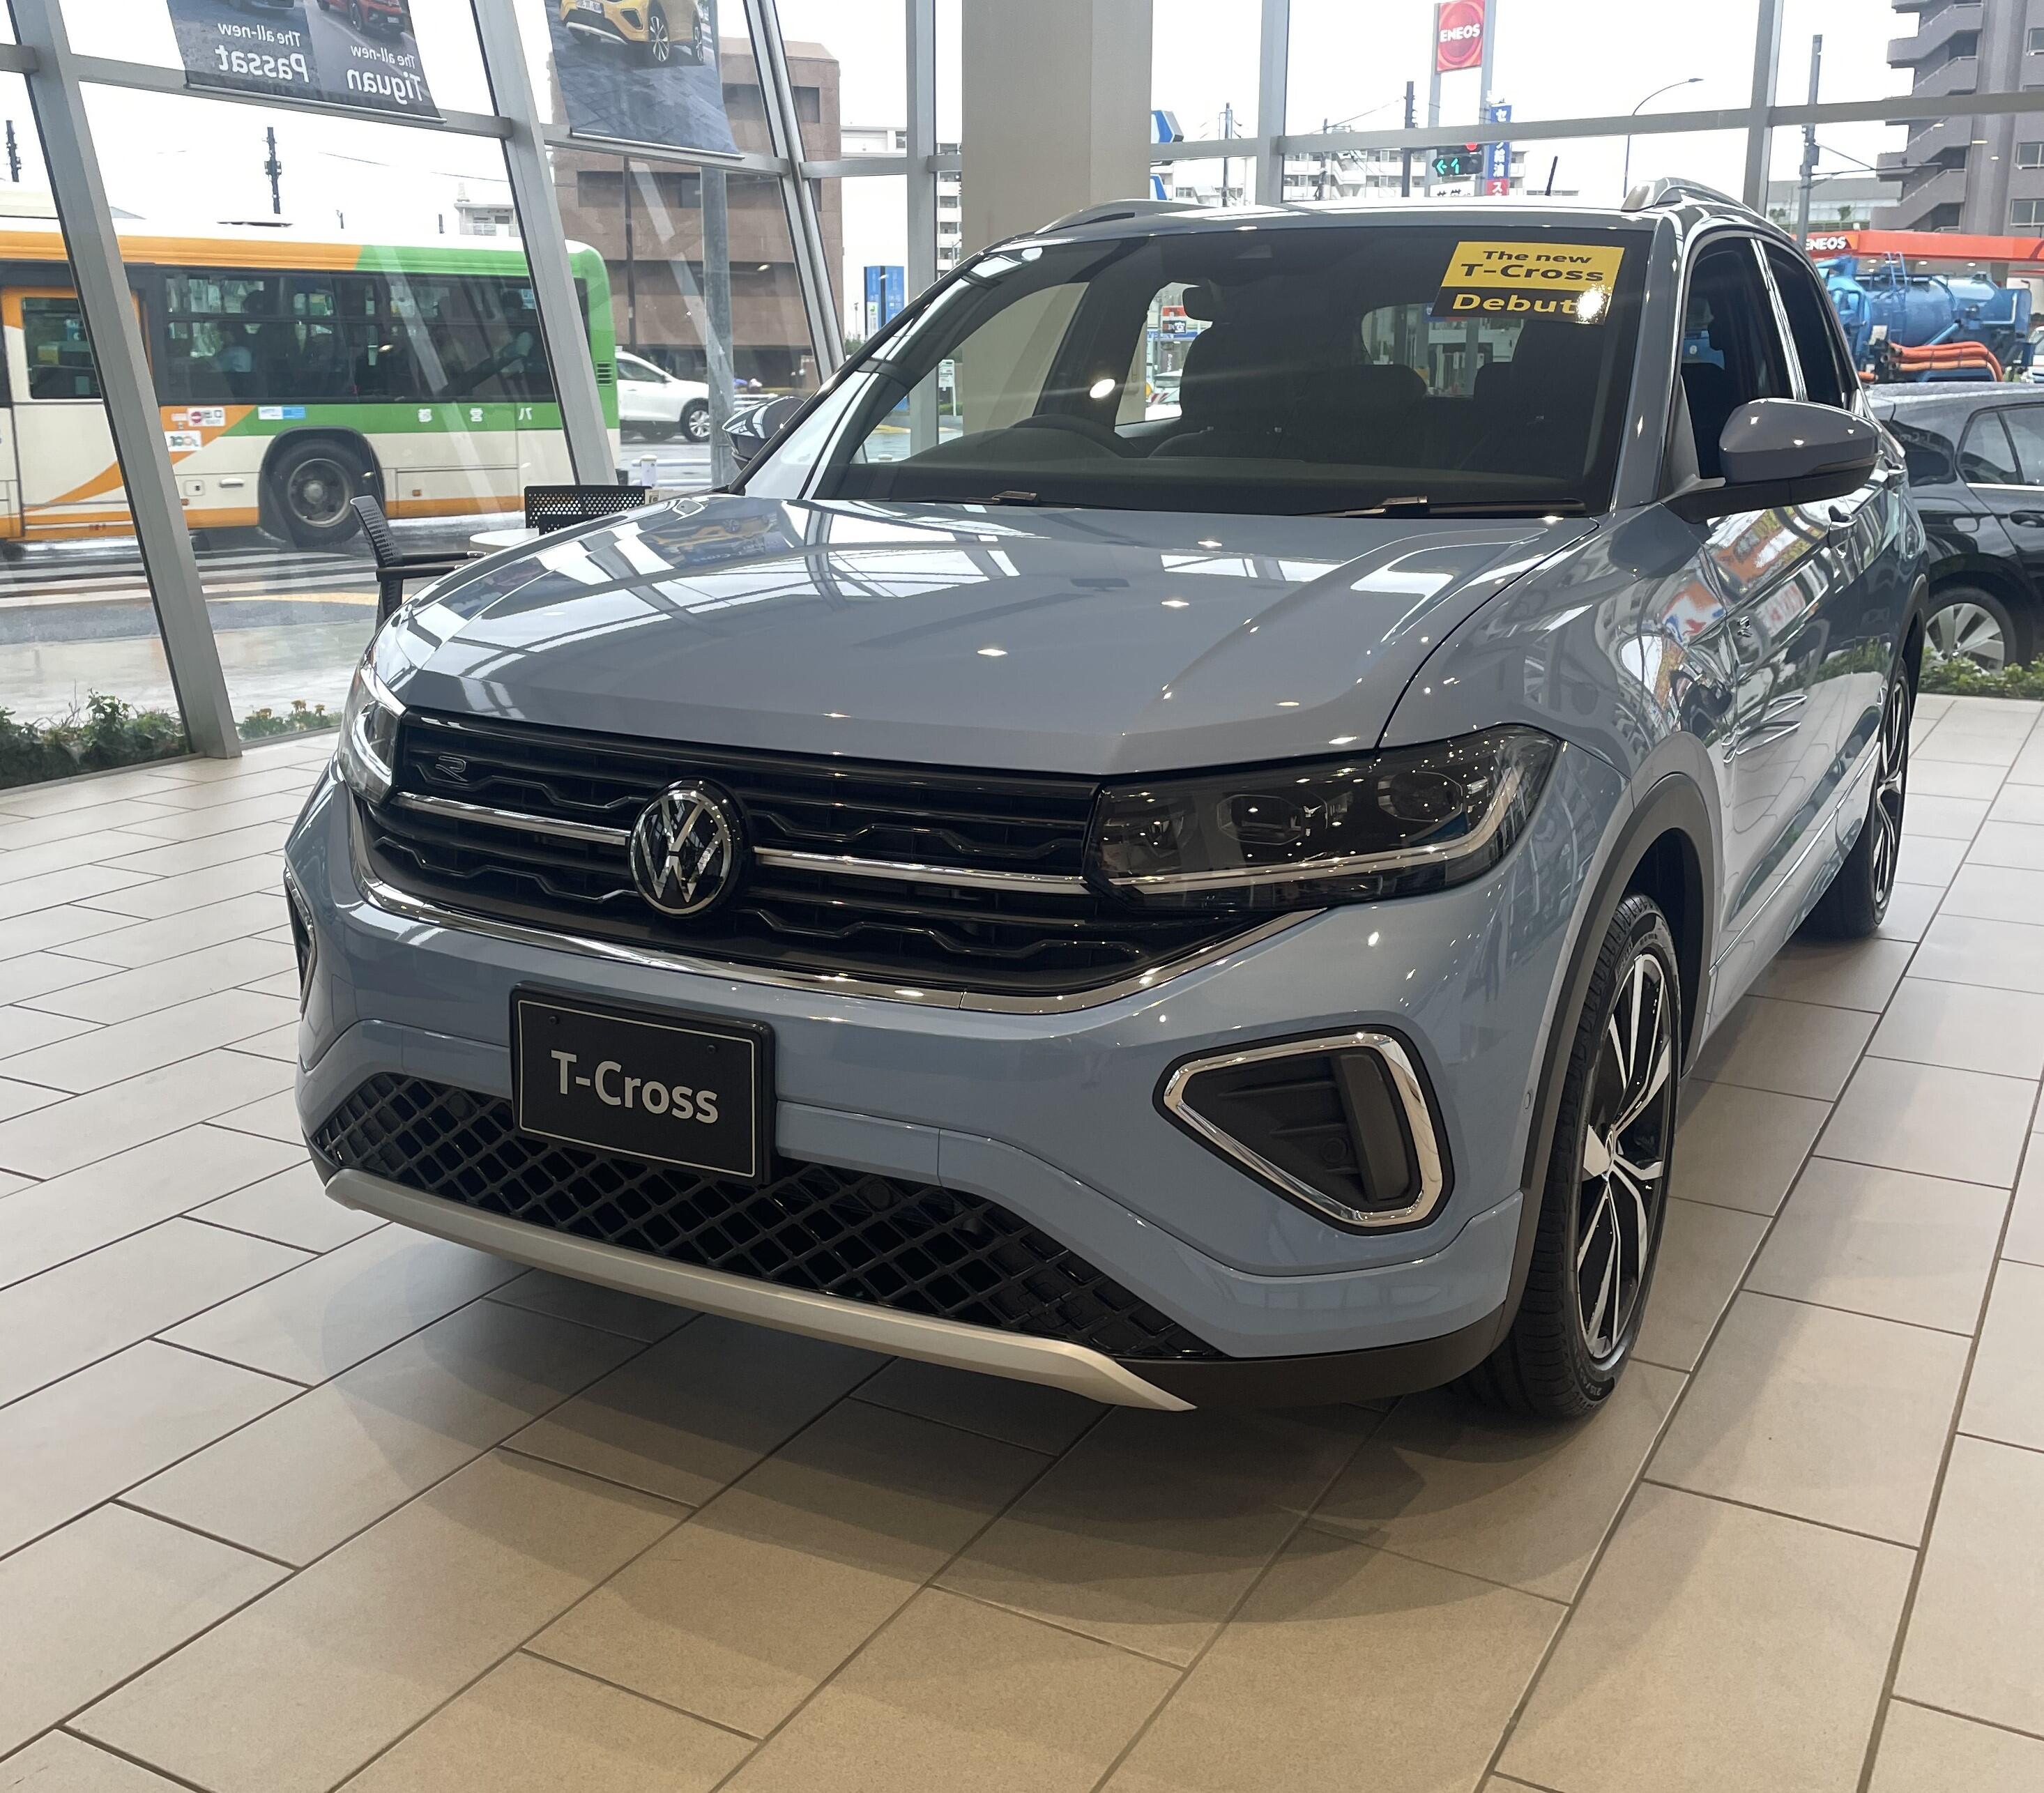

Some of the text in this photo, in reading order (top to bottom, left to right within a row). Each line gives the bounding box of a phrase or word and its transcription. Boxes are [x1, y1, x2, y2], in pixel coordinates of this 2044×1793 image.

[1439, 24, 1481, 43] ENEOS
[1483, 251, 1592, 264] The new
[1461, 264, 1603, 282] T-Cross
[551, 1049, 719, 1124] T-Cross
